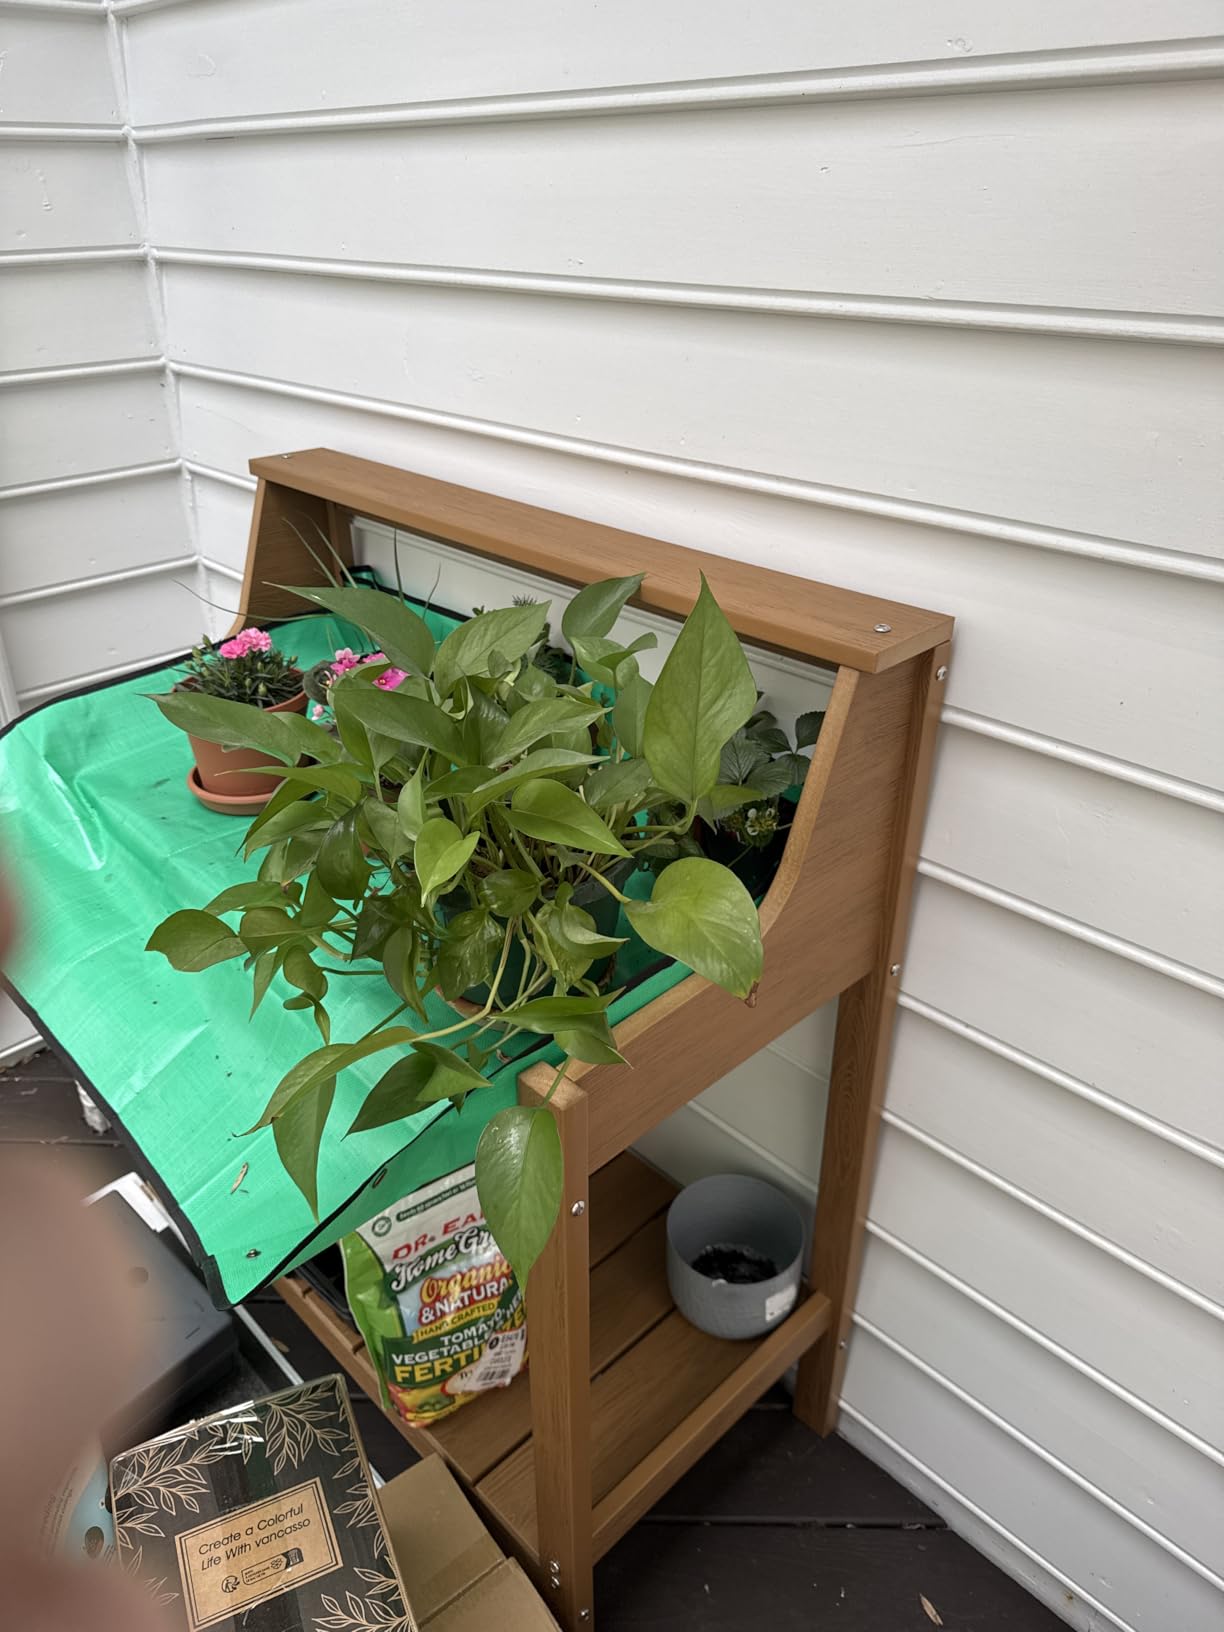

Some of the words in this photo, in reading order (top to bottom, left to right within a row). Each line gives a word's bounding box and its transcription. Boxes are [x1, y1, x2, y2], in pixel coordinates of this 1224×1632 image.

[443, 1212, 486, 1234] EA
[391, 1242, 456, 1291] Home
[420, 1320, 448, 1336] HAND
[451, 1302, 495, 1325] CRAFTED
[394, 1345, 486, 1384] FERTI
[198, 1532, 241, 1556] Create
[245, 1527, 254, 1537] a
[257, 1503, 304, 1532] Colorful
[201, 1553, 222, 1572] Life
[225, 1542, 252, 1562] With
[255, 1518, 311, 1548] vancasso
